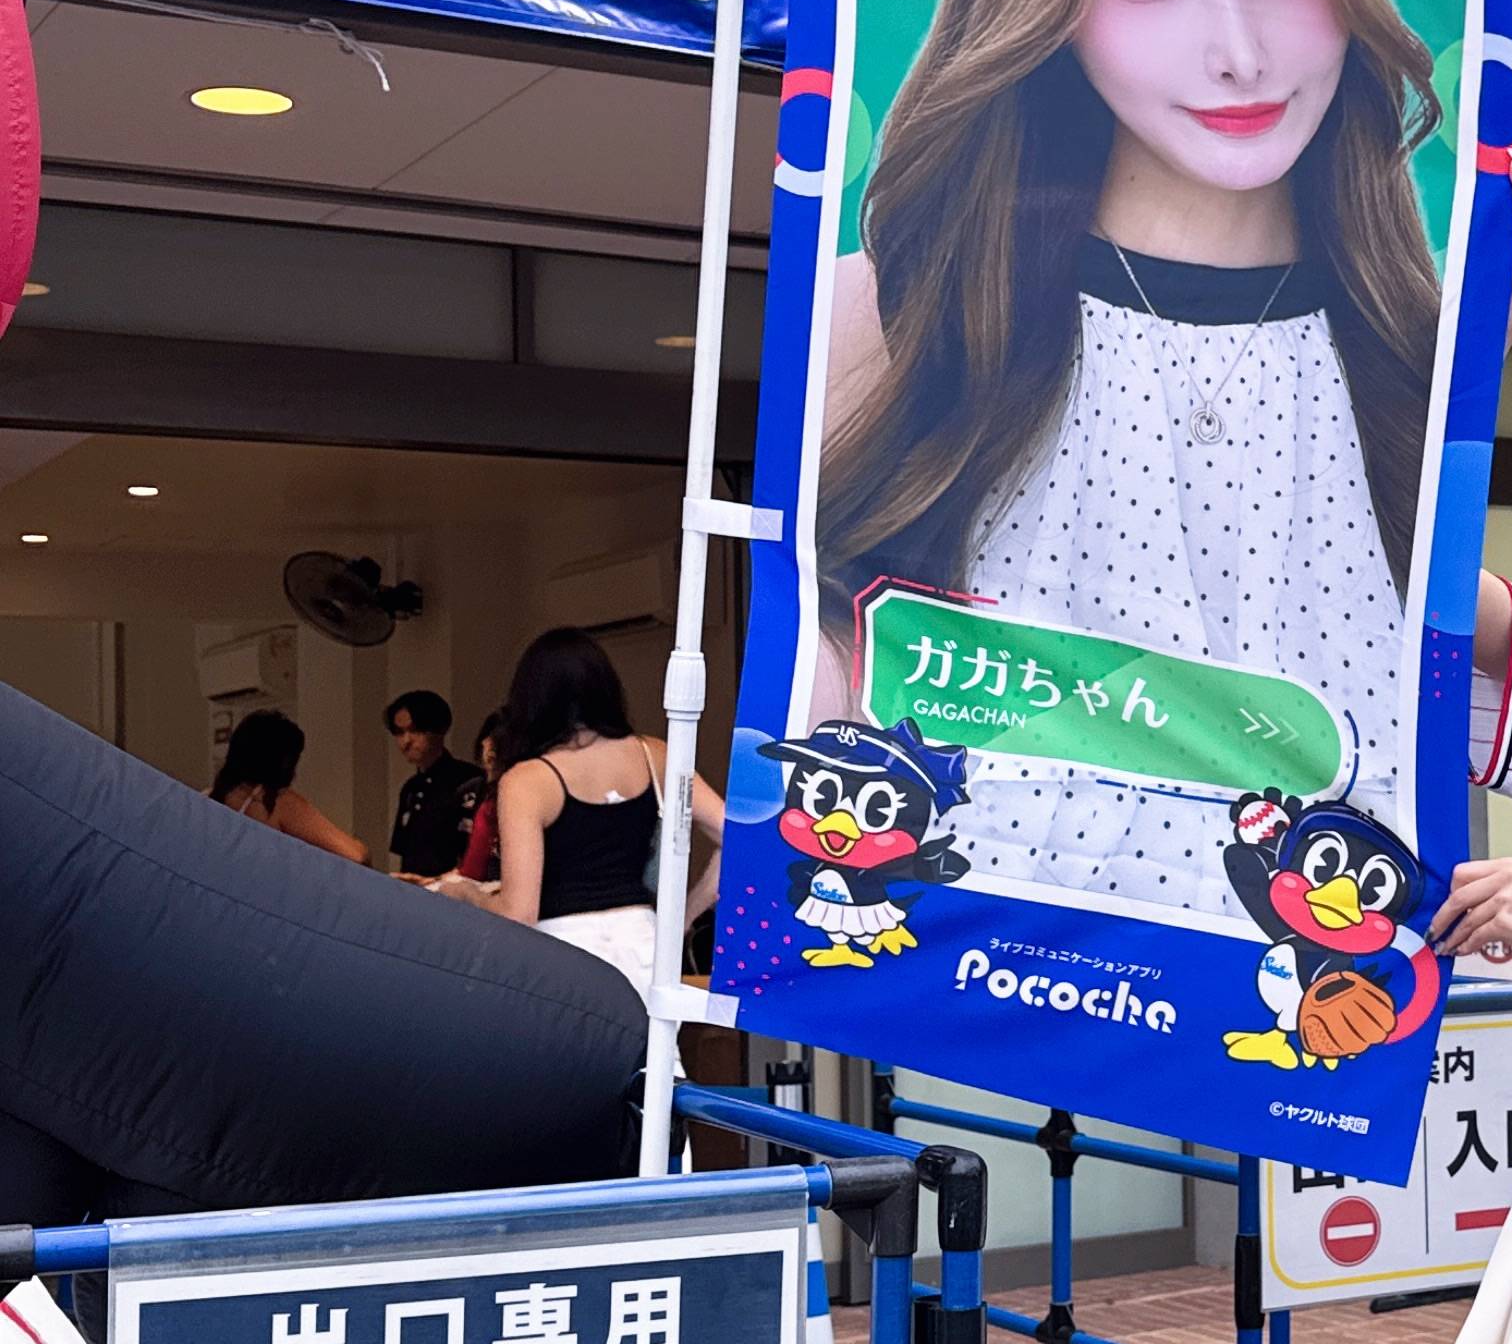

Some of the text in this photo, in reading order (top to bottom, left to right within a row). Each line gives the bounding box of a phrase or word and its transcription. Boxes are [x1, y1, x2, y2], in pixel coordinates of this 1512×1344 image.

[904, 635, 1170, 729] ガガちゃん
[913, 699, 1027, 729] GAGACHAN
[989, 937, 1163, 980] ライブコミュニケーションアプリ
[953, 948, 1177, 1035] Pococha
